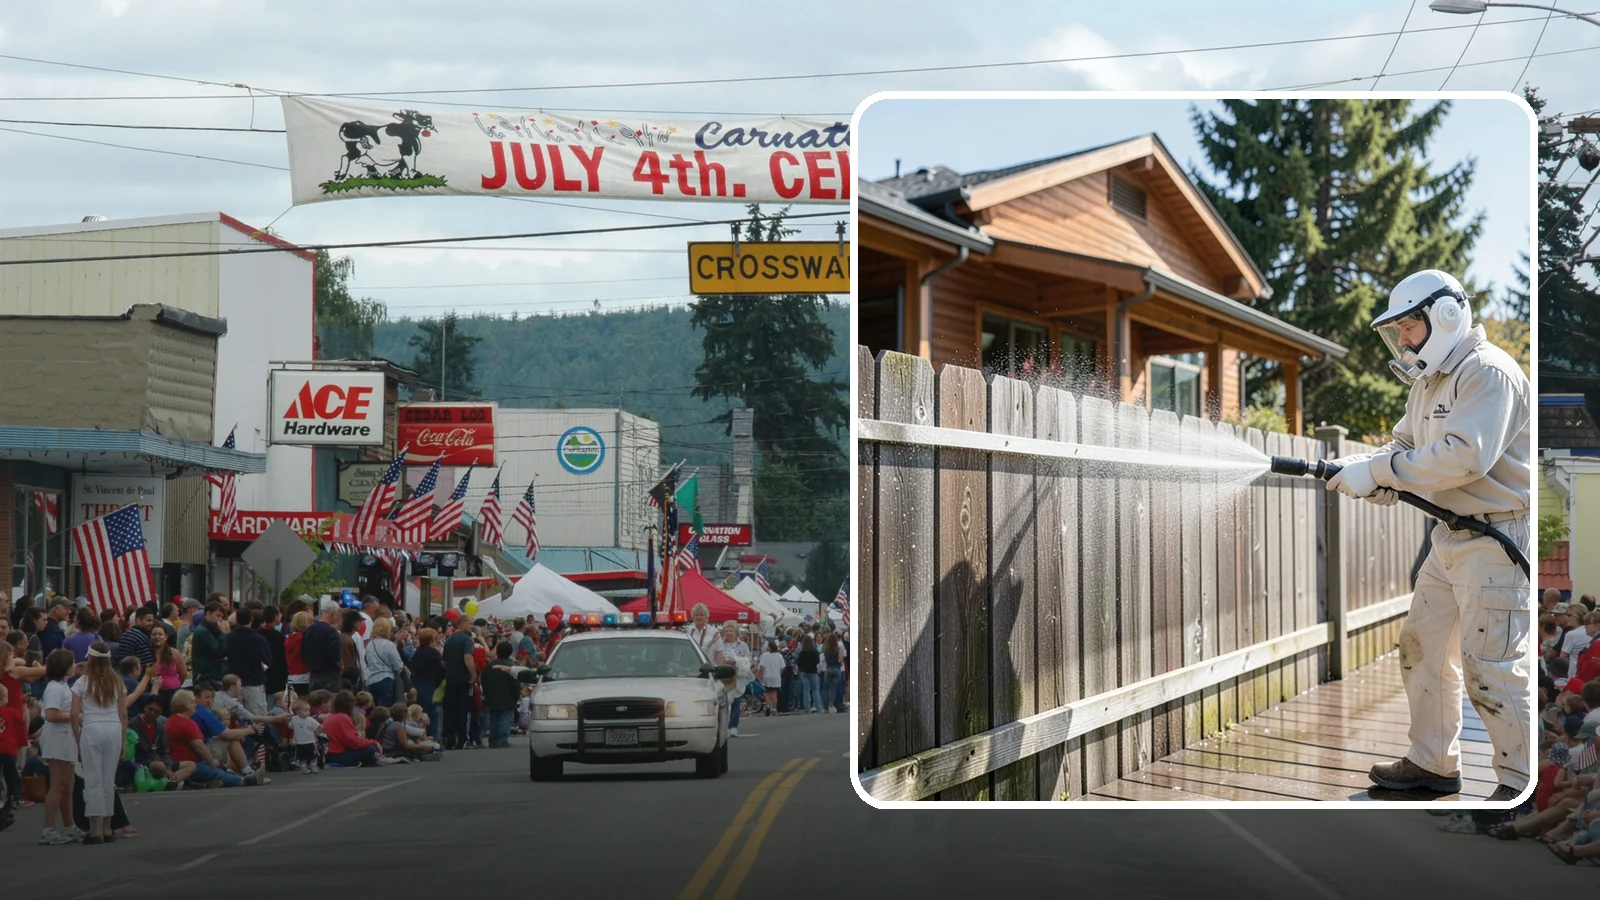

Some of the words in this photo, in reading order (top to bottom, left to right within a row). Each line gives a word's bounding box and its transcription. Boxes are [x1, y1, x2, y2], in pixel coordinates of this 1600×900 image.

[695, 121, 850, 149] Carnat
[481, 141, 604, 192] JULY
[632, 150, 746, 198] 4th.
[697, 254, 850, 280] CROSSWA
[283, 380, 373, 420] ACE
[406, 409, 452, 421] CEDAR
[461, 409, 485, 421] LOG
[283, 421, 371, 436] Hardware
[416, 423, 477, 447] Coca-Cola
[83, 485, 93, 494] St.
[96, 485, 124, 494] Vincent
[126, 485, 135, 494] de
[137, 485, 155, 495] Paul
[688, 526, 742, 535] CRNATION
[699, 535, 730, 543] GLASS
